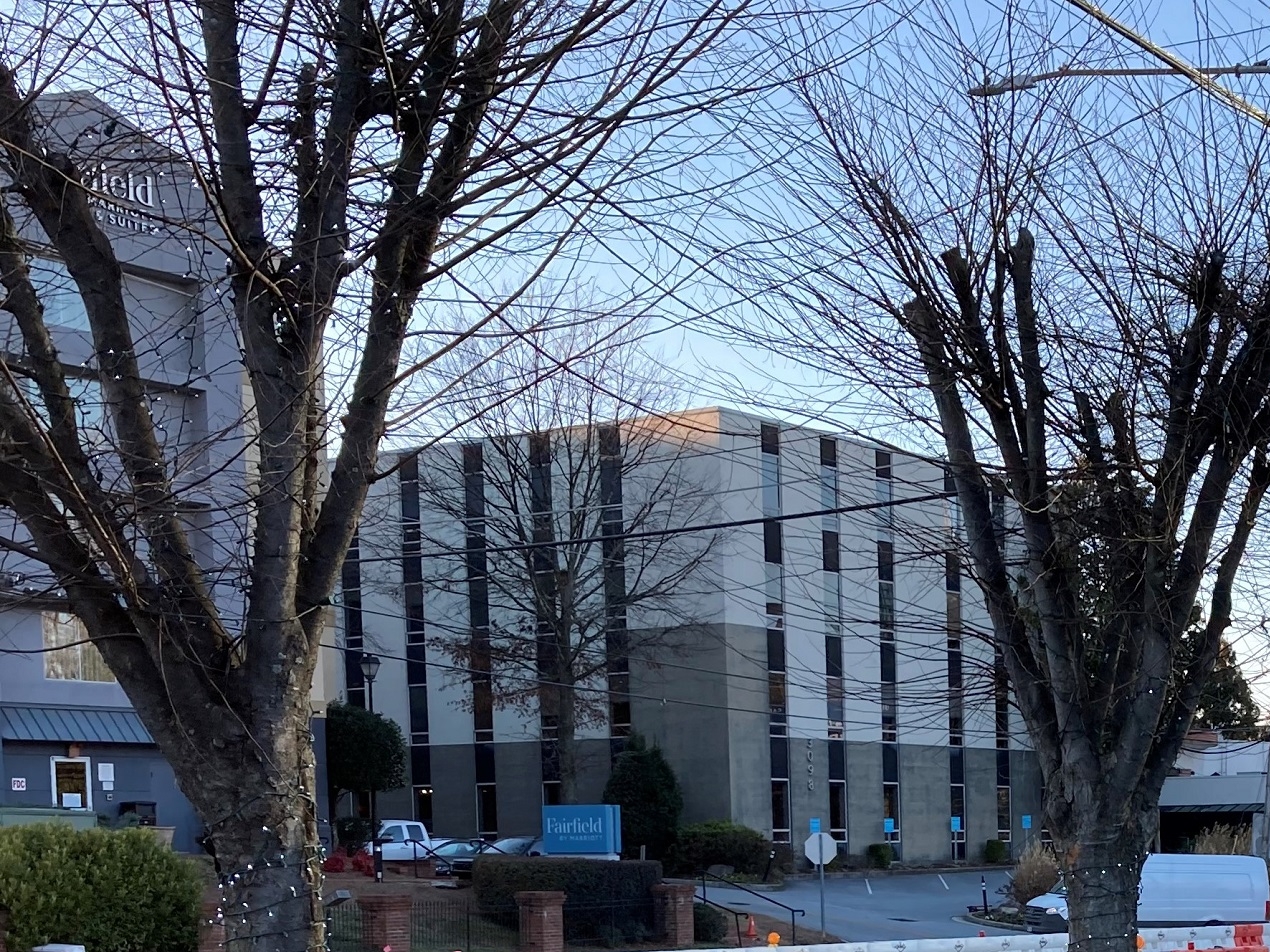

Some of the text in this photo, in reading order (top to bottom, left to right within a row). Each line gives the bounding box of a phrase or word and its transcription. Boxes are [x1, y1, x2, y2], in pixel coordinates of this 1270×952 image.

[109, 213, 159, 235] SUITES
[12, 780, 26, 789] FDC
[546, 817, 603, 834] Fairfield
